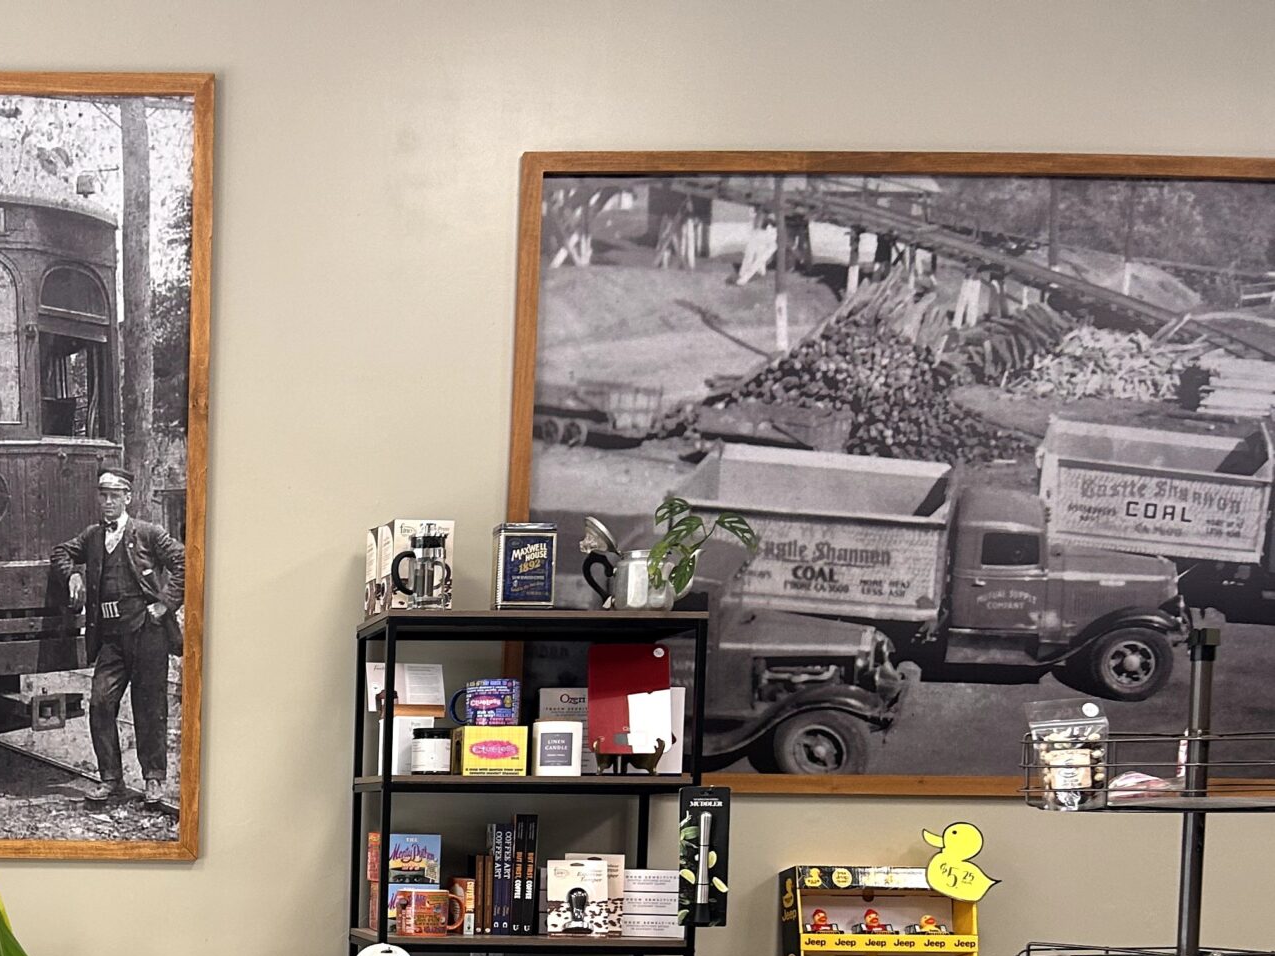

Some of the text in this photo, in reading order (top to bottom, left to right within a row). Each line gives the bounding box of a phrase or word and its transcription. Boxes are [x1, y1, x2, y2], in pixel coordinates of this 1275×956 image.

[1125, 501, 1193, 523] COAL
[511, 542, 548, 560] MAXWELL
[525, 550, 548, 562] HOUSE
[518, 559, 541, 574] 1892
[791, 565, 838, 583] COAL
[493, 831, 504, 880] COFFEE ART
[503, 831, 512, 880] COFFEE ART
[513, 879, 522, 899] COFFEE
[804, 936, 977, 949] Jeep Jeep Jeep Jeep Jeep Jeep
